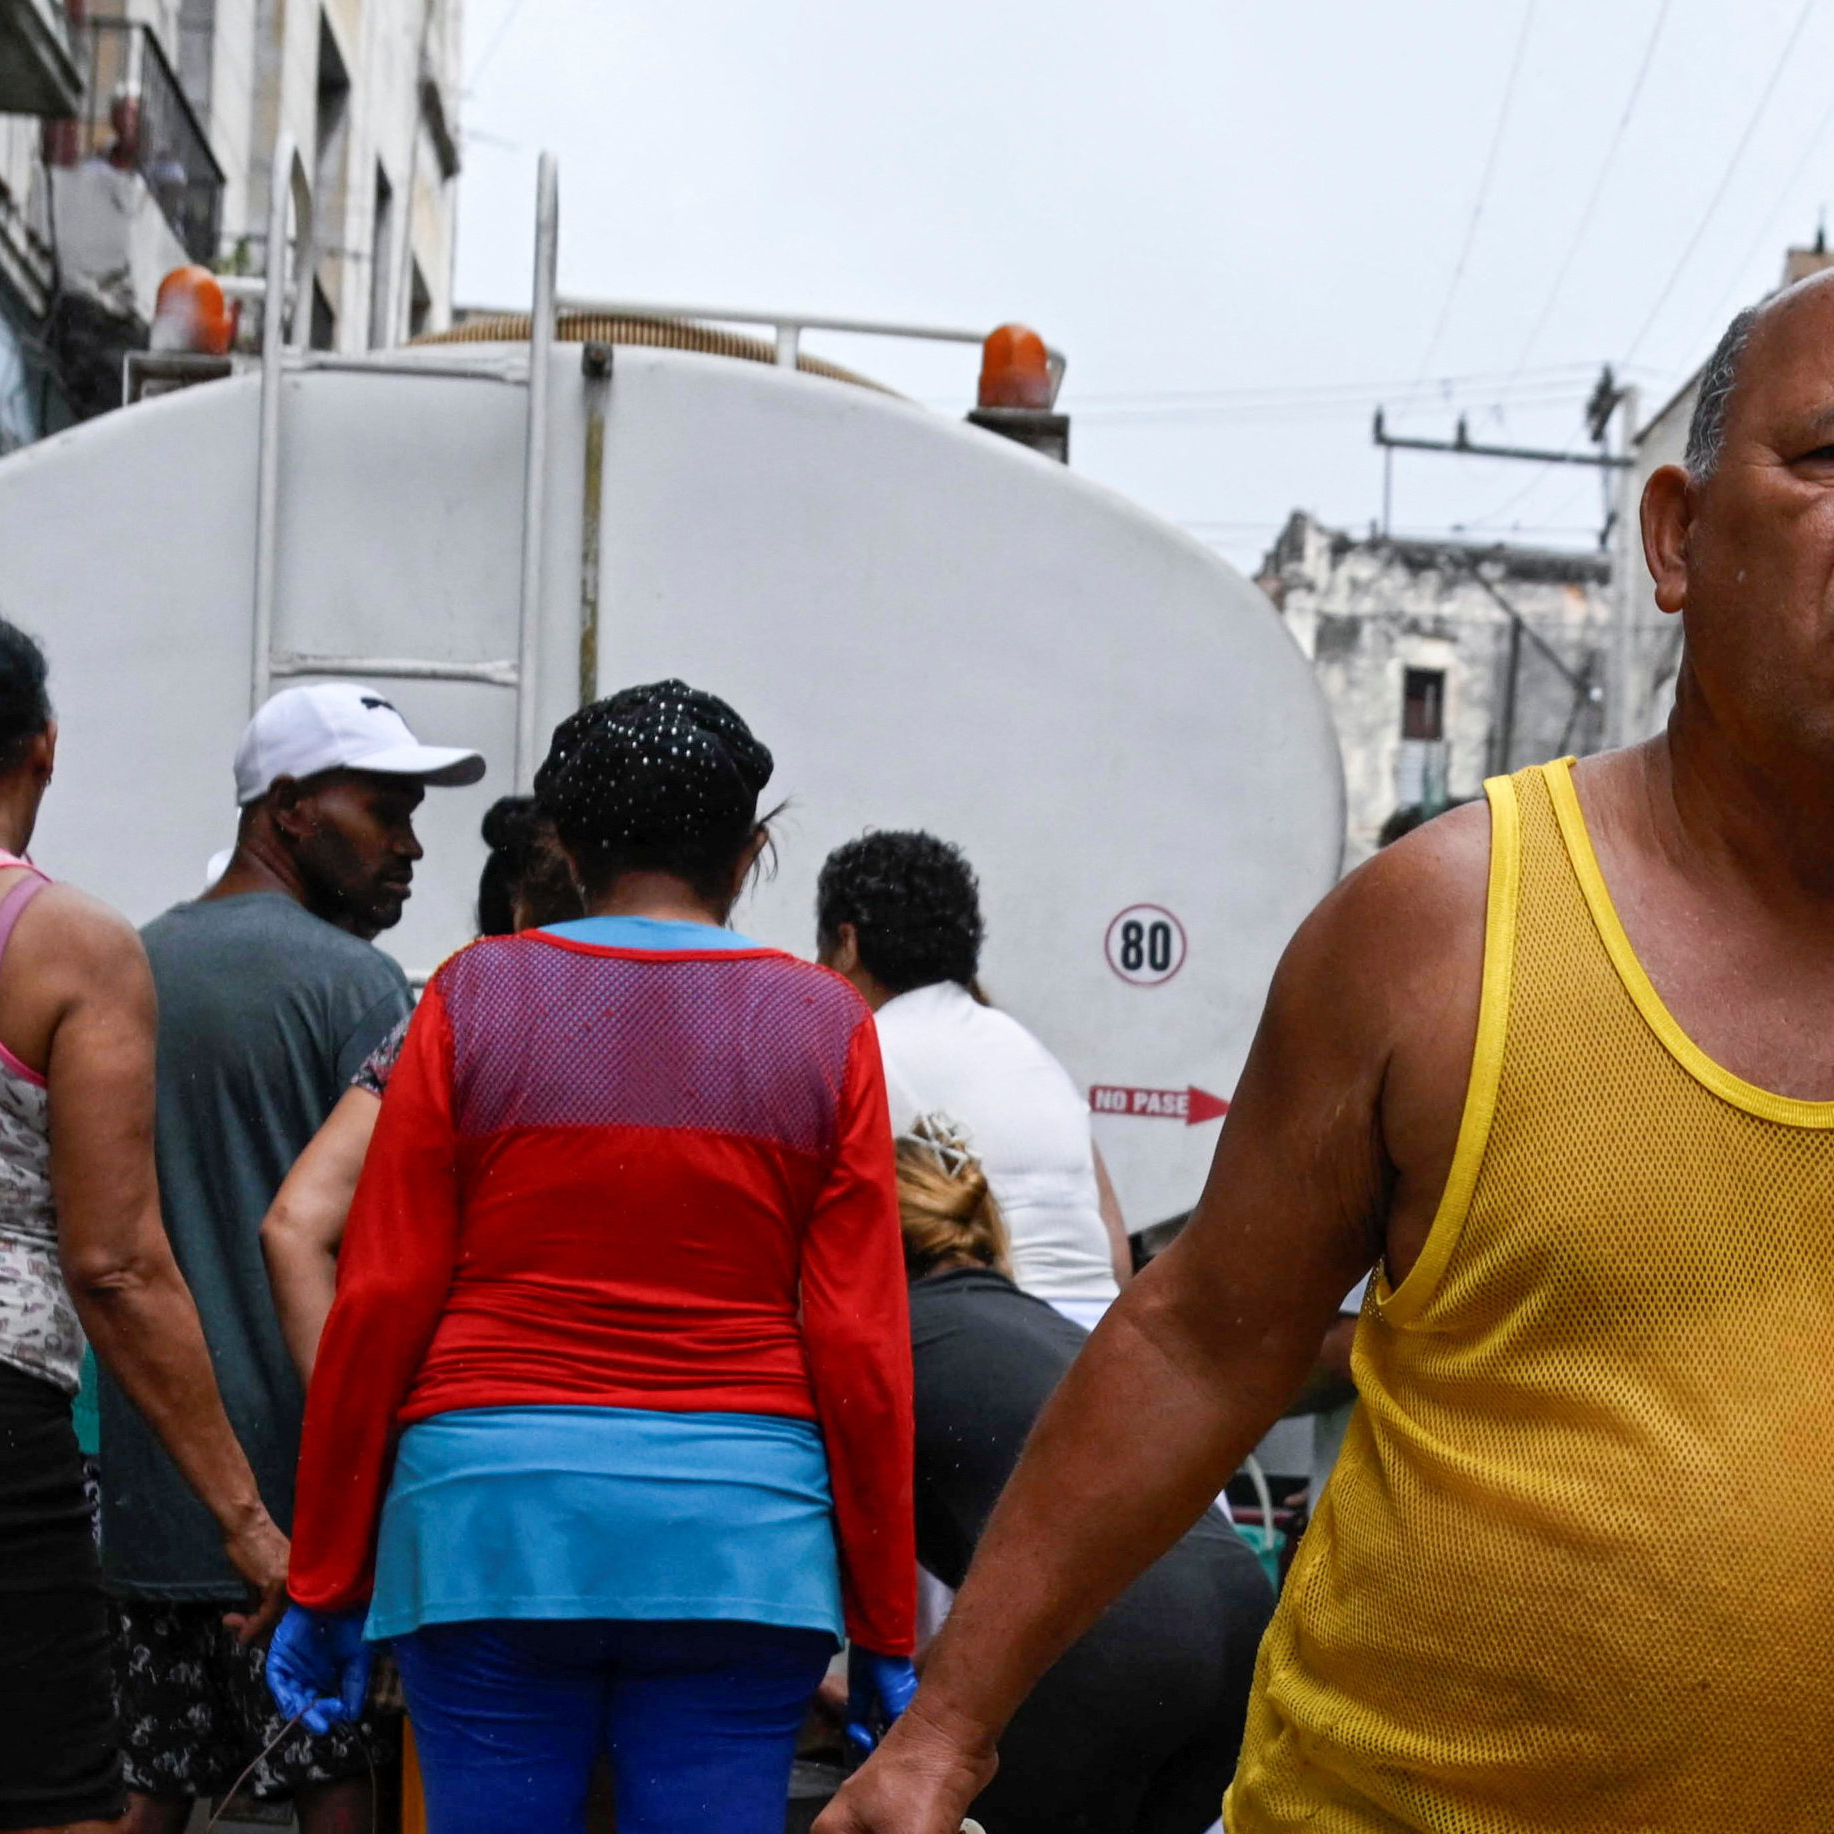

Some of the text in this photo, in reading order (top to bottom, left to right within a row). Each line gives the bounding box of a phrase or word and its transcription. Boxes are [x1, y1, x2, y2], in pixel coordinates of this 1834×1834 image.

[1120, 919, 1172, 972] 80
[1094, 1089, 1188, 1116] NO PASE
